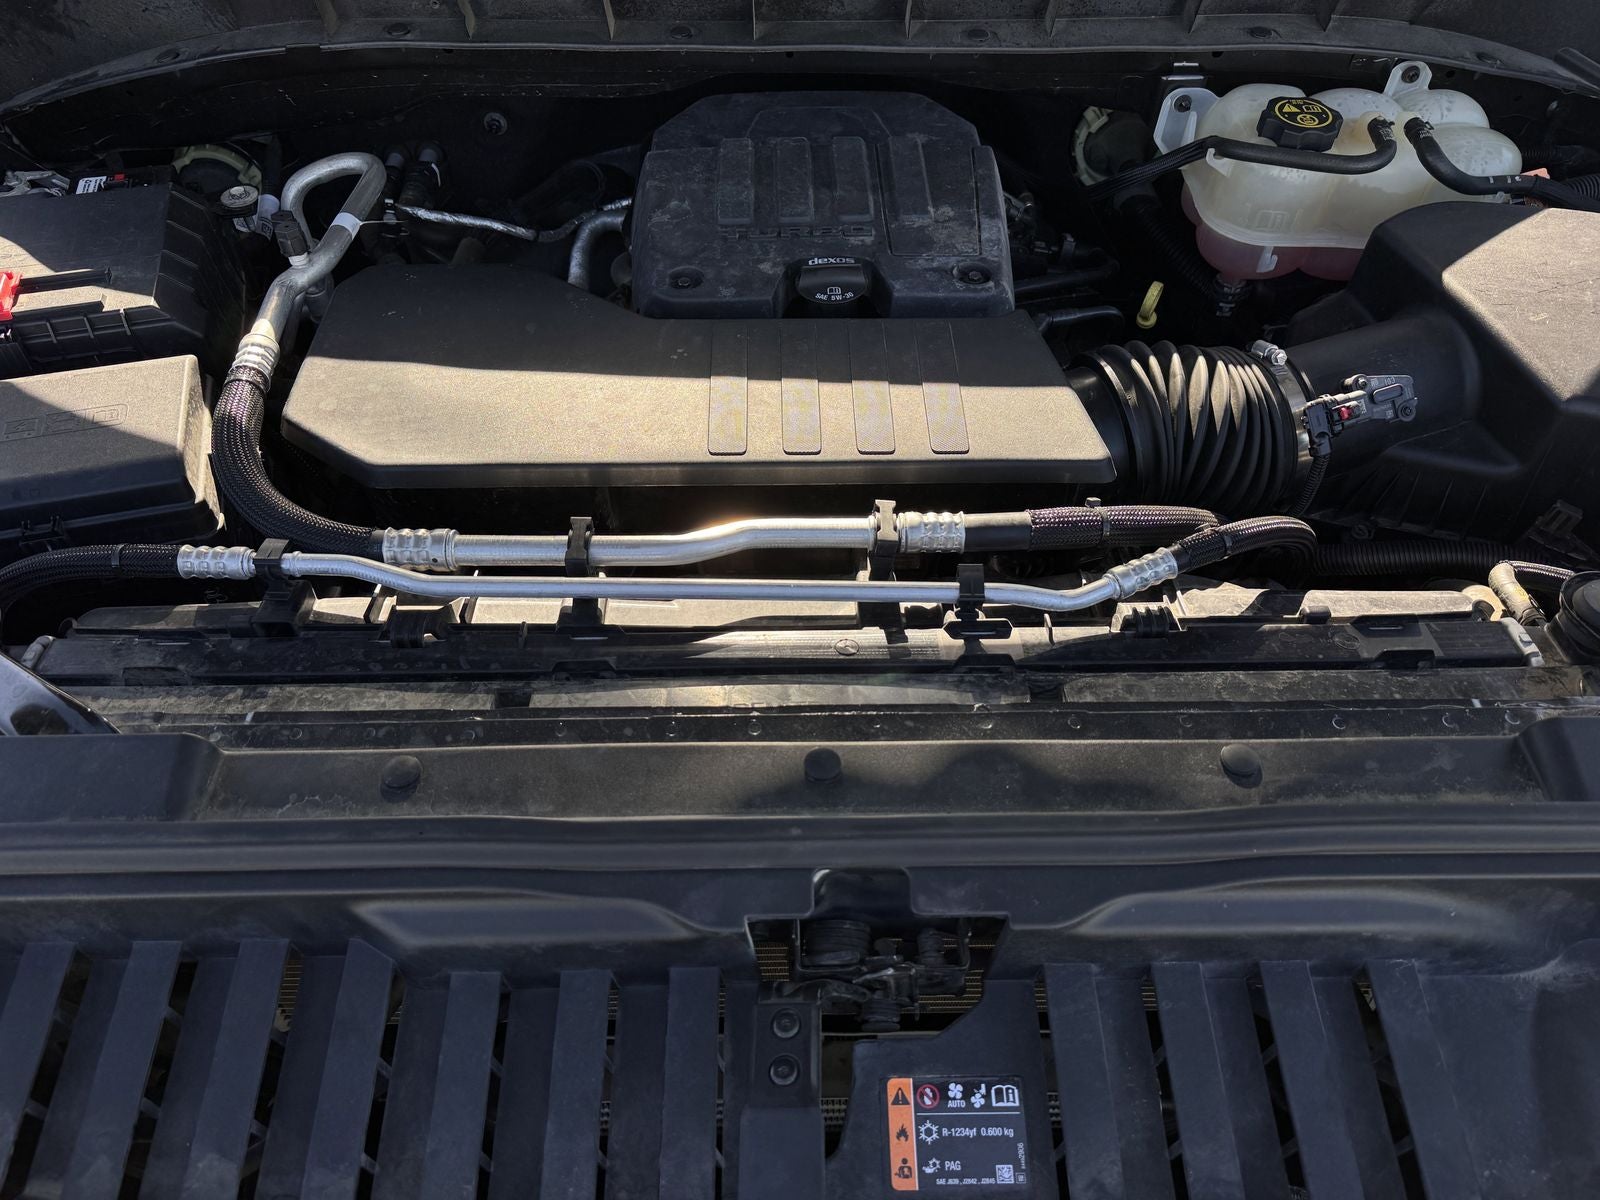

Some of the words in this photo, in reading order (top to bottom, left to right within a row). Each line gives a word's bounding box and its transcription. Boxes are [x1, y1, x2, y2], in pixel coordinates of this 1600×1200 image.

[808, 257, 855, 265] dexos
[815, 292, 828, 300] SAE
[831, 291, 854, 301] 5W-30
[947, 1100, 966, 1108] AUTO
[942, 1127, 977, 1138] R-1234yf
[981, 1127, 1002, 1136] 0.600
[1003, 1127, 1014, 1138] kg
[945, 1161, 961, 1171] PAG
